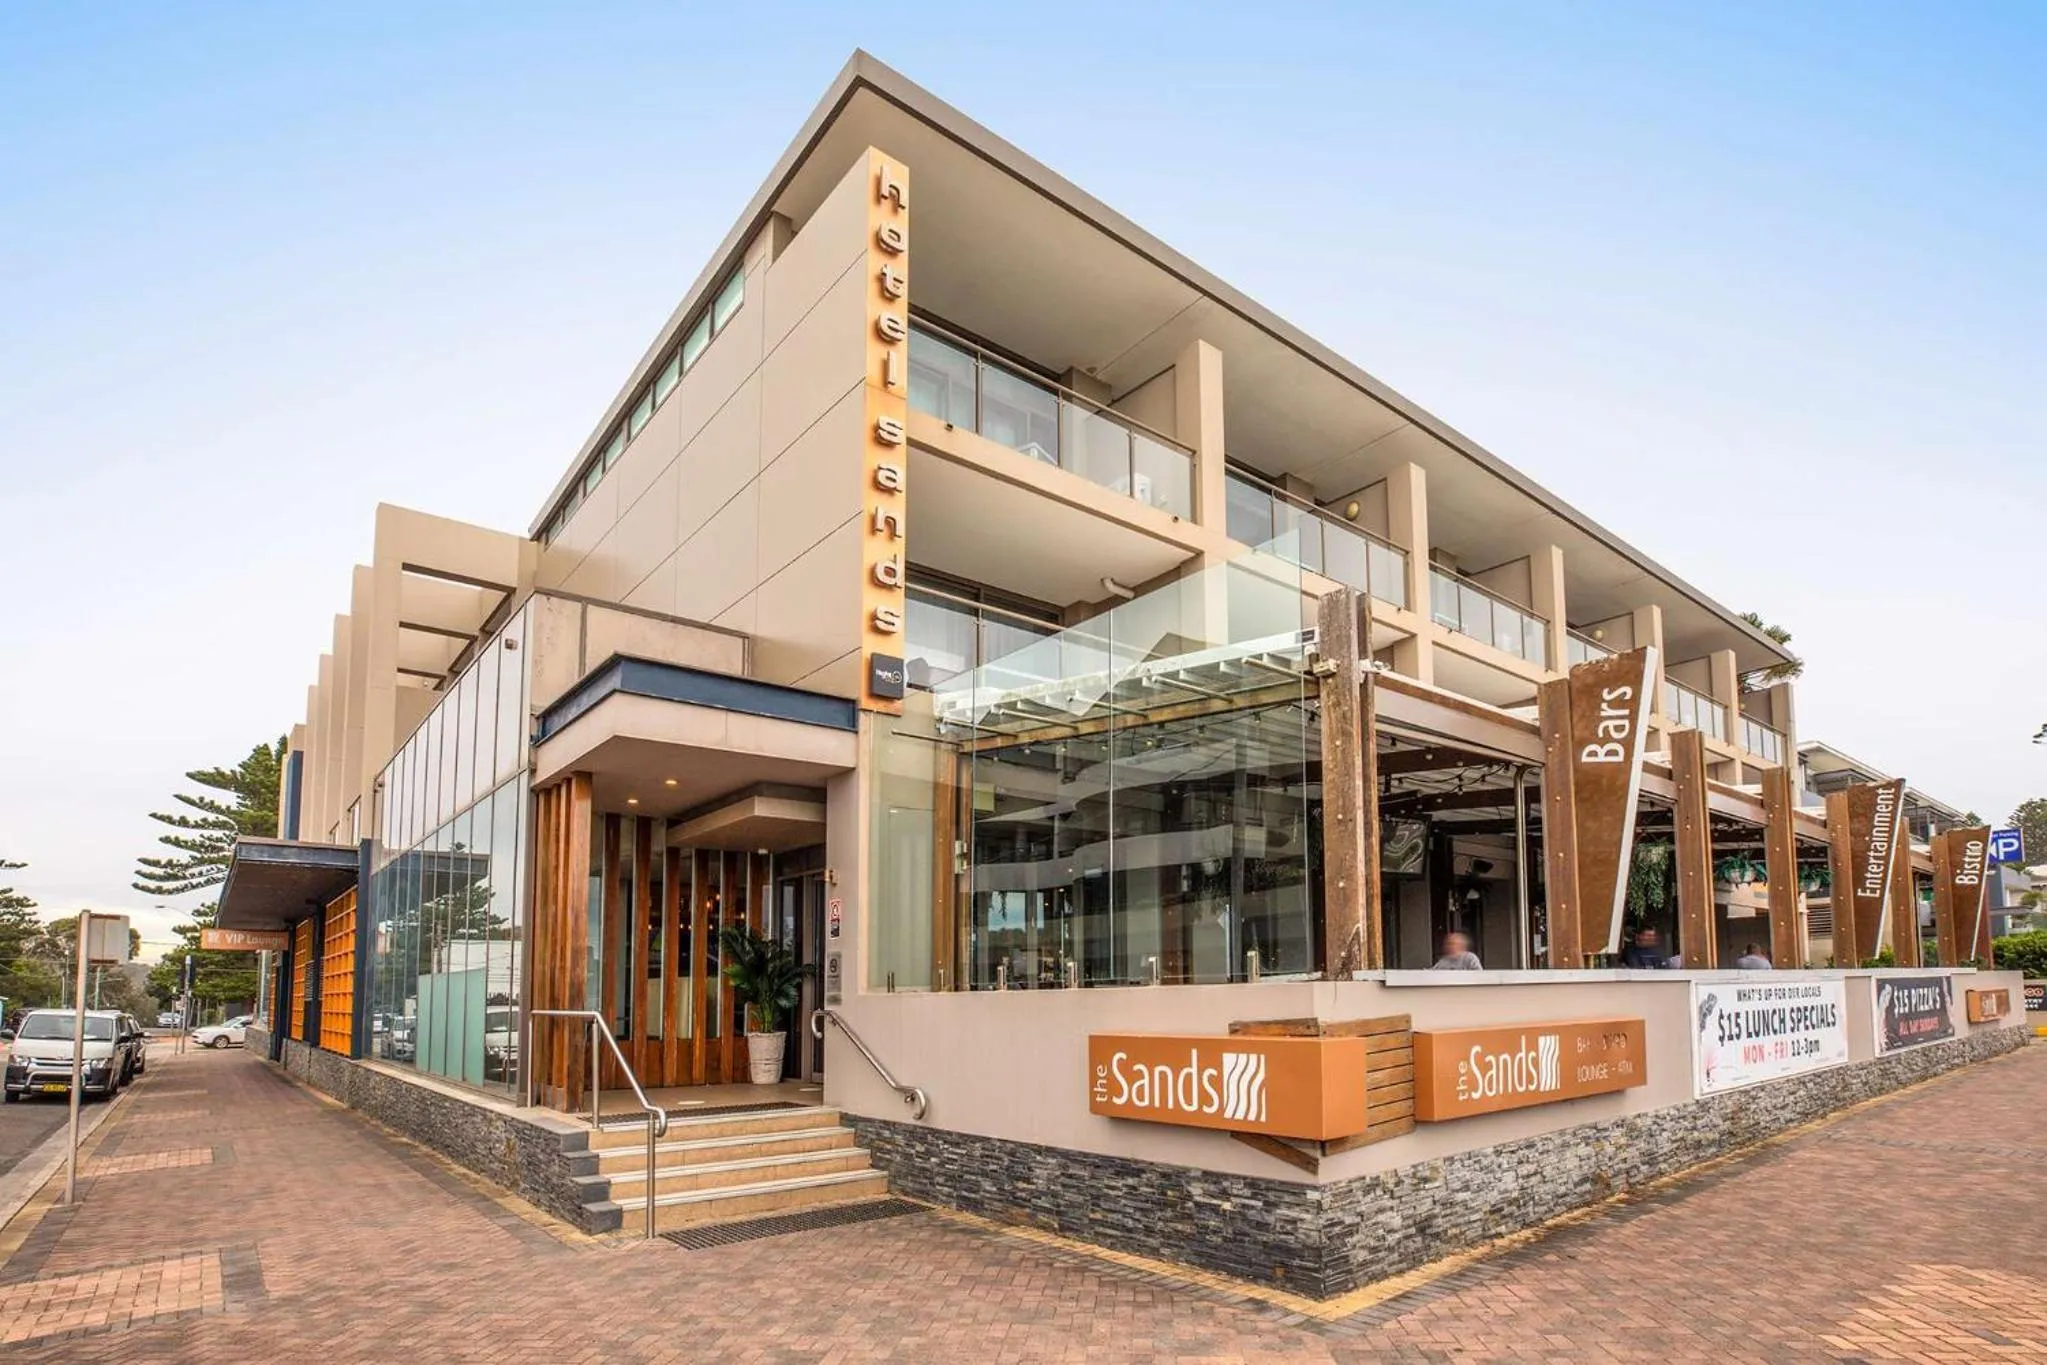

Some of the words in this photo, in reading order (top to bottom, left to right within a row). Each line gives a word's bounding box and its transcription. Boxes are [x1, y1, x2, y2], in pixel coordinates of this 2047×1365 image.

[877, 163, 906, 386] hotel
[874, 415, 903, 634] sands
[1581, 686, 1632, 763] Bars
[1857, 787, 1896, 898] Entertainment
[1954, 840, 1984, 885] Bistro
[225, 933, 245, 945] VIP
[246, 934, 285, 947] Lounge
[1736, 988, 1763, 1002] WHAT'S
[1764, 988, 1772, 1001] UP
[1774, 987, 1787, 1000] FOR
[1801, 985, 1822, 998] LOCALS
[1894, 985, 1909, 1019] $15
[1718, 1008, 1742, 1047] $15
[1745, 1008, 1787, 1039] LUNCH
[1789, 1003, 1837, 1034] SPECIALS
[1743, 1043, 1765, 1065] MON
[1774, 1041, 1789, 1060] FRI
[1791, 1037, 1820, 1058] 12-3pm
[1094, 1064, 1108, 1103] the
[1111, 1048, 1220, 1114] Sands
[1456, 1061, 1469, 1101] the
[1470, 1034, 1538, 1100] Sands
